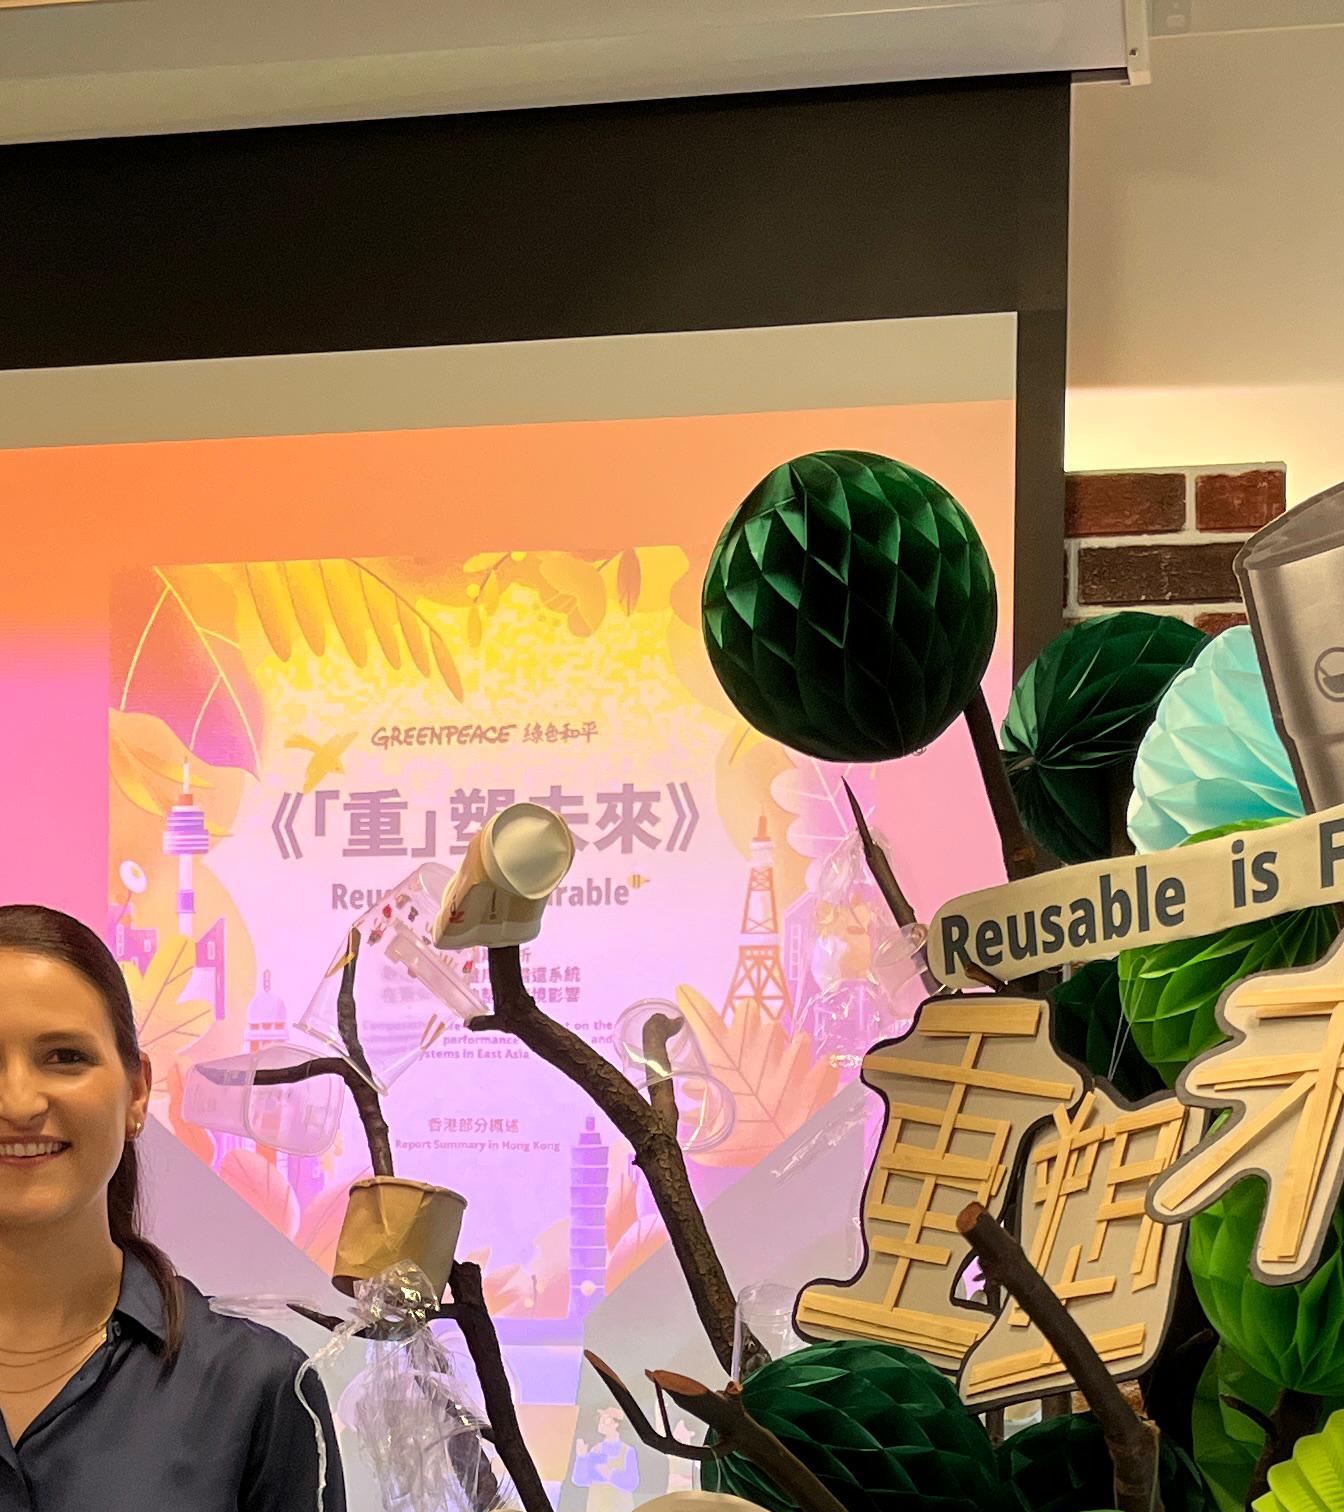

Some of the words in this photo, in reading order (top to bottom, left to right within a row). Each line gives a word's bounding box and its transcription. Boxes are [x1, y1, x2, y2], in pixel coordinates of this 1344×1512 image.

[371, 724, 517, 750] GREENPEACE
[940, 865, 1186, 975] Reusable
[1231, 839, 1279, 908] is
